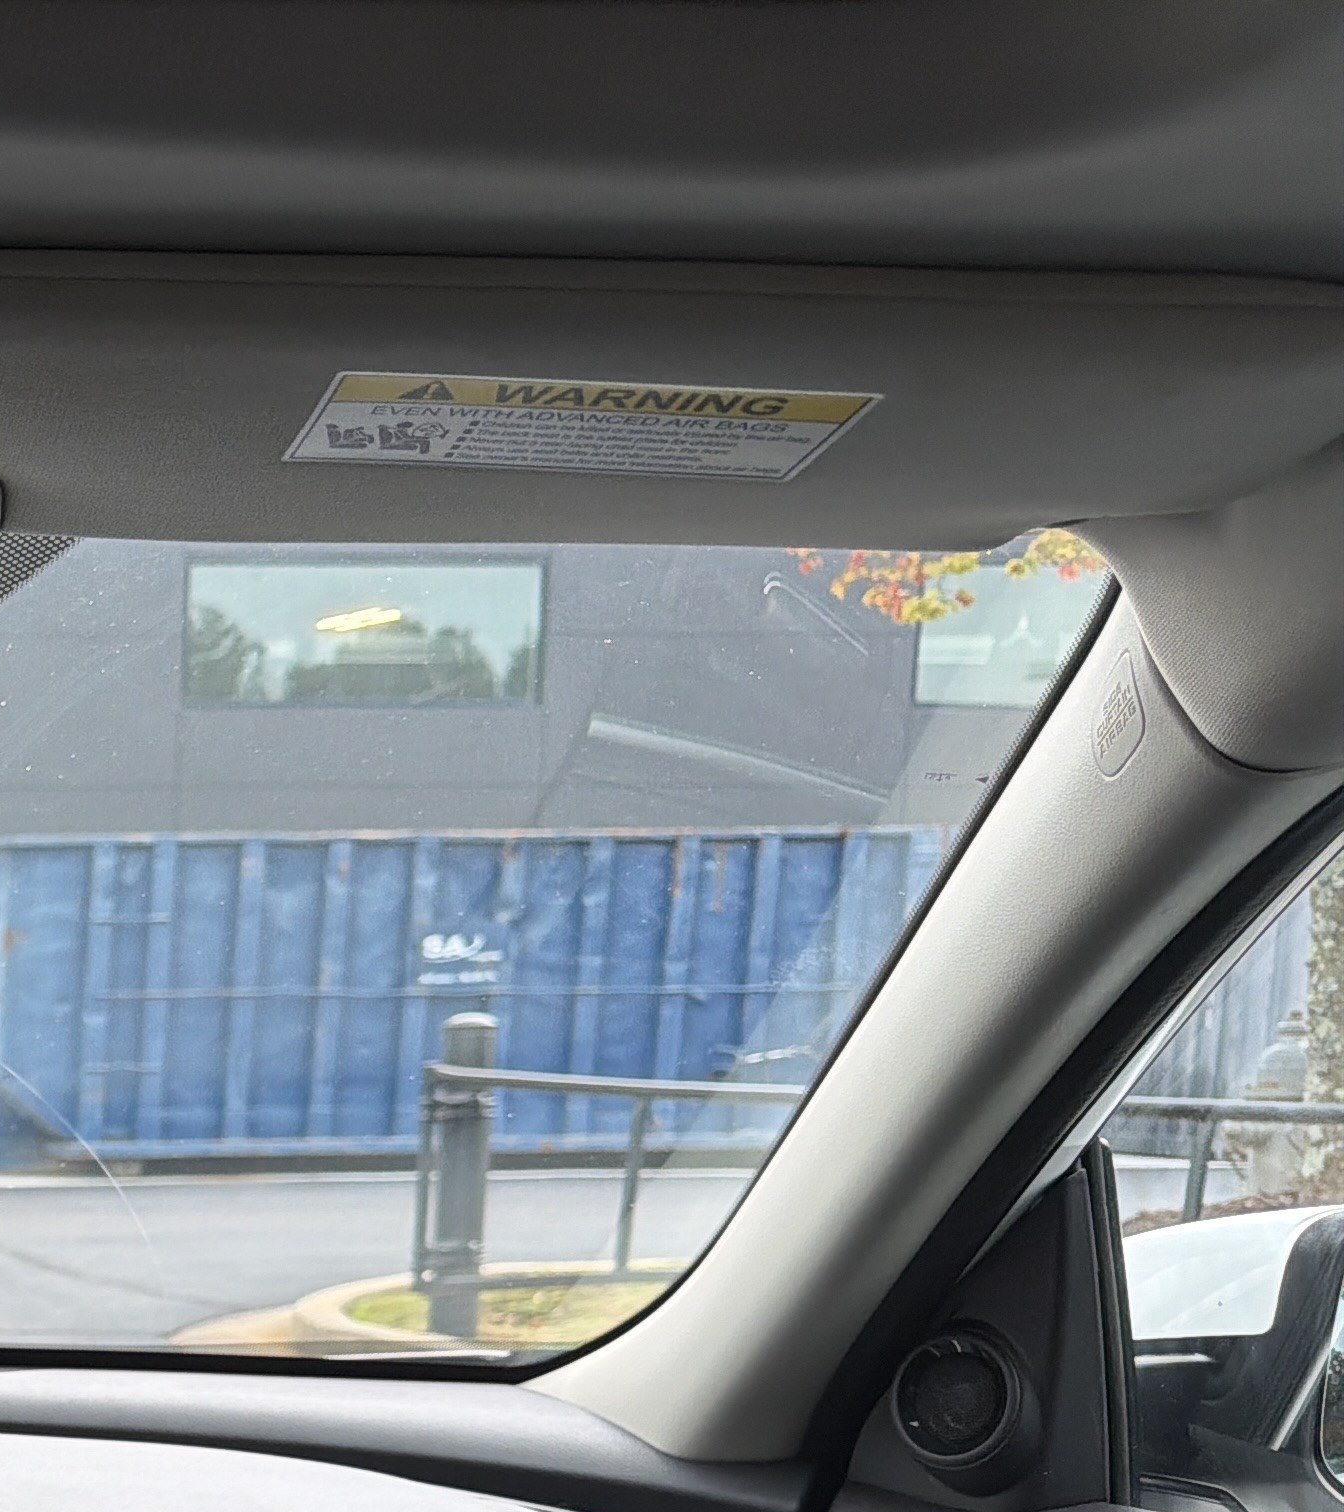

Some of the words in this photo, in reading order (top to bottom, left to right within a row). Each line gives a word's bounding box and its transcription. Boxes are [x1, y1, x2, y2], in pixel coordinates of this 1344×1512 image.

[496, 383, 789, 415] WARNING
[370, 404, 438, 417] EVEN
[449, 407, 514, 420] WITH
[516, 410, 661, 426] ADVANCED
[662, 418, 710, 429] AIR
[715, 420, 791, 433] BAGS
